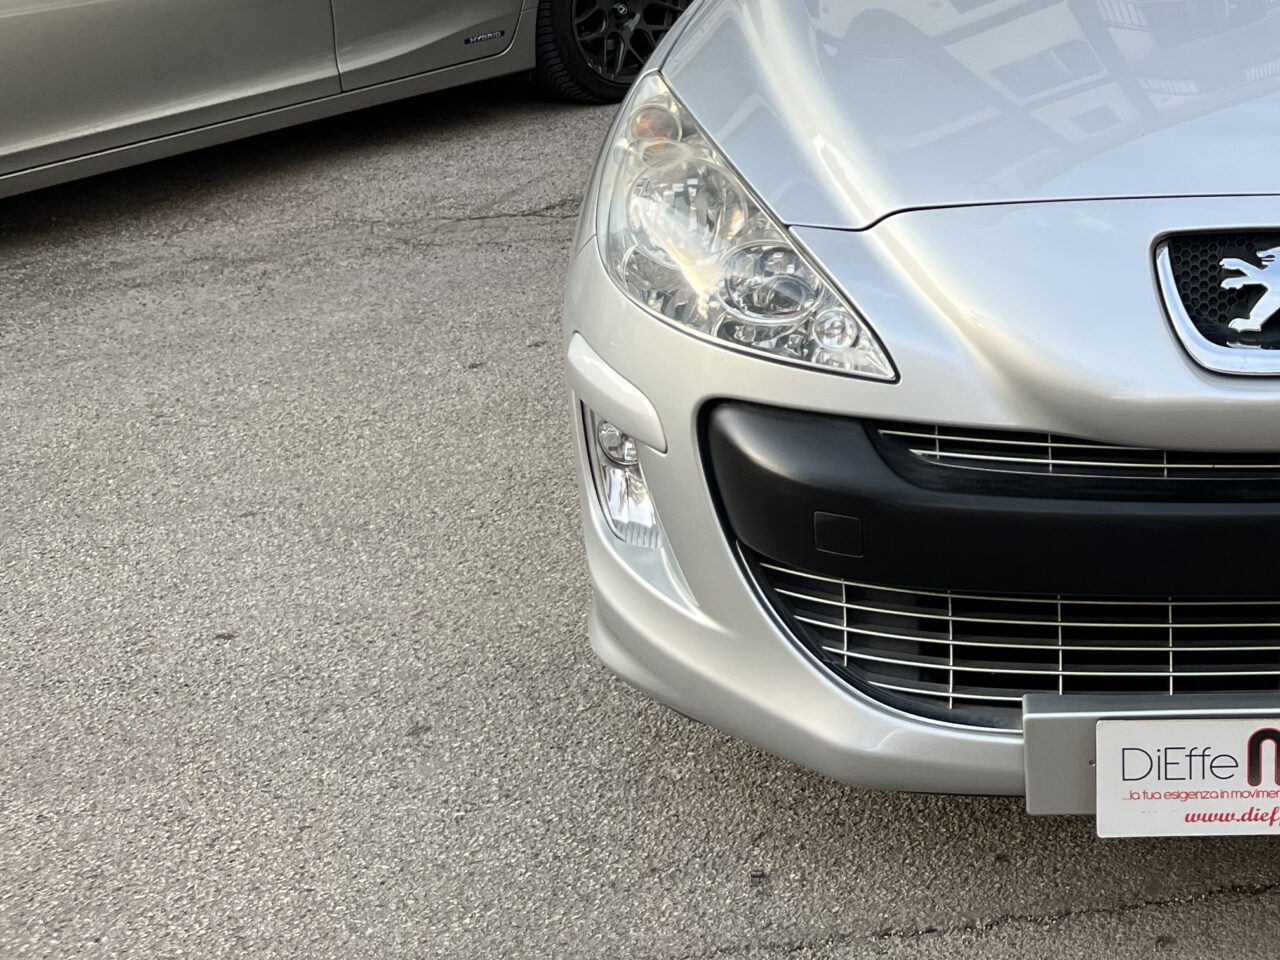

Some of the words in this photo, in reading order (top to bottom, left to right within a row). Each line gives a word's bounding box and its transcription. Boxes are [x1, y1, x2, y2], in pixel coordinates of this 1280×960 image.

[470, 32, 501, 43] HYBRID
[1122, 746, 1239, 781] DiEffe
[1143, 789, 1162, 800] tua
[1163, 789, 1219, 802] esigenza
[1220, 789, 1230, 799] in
